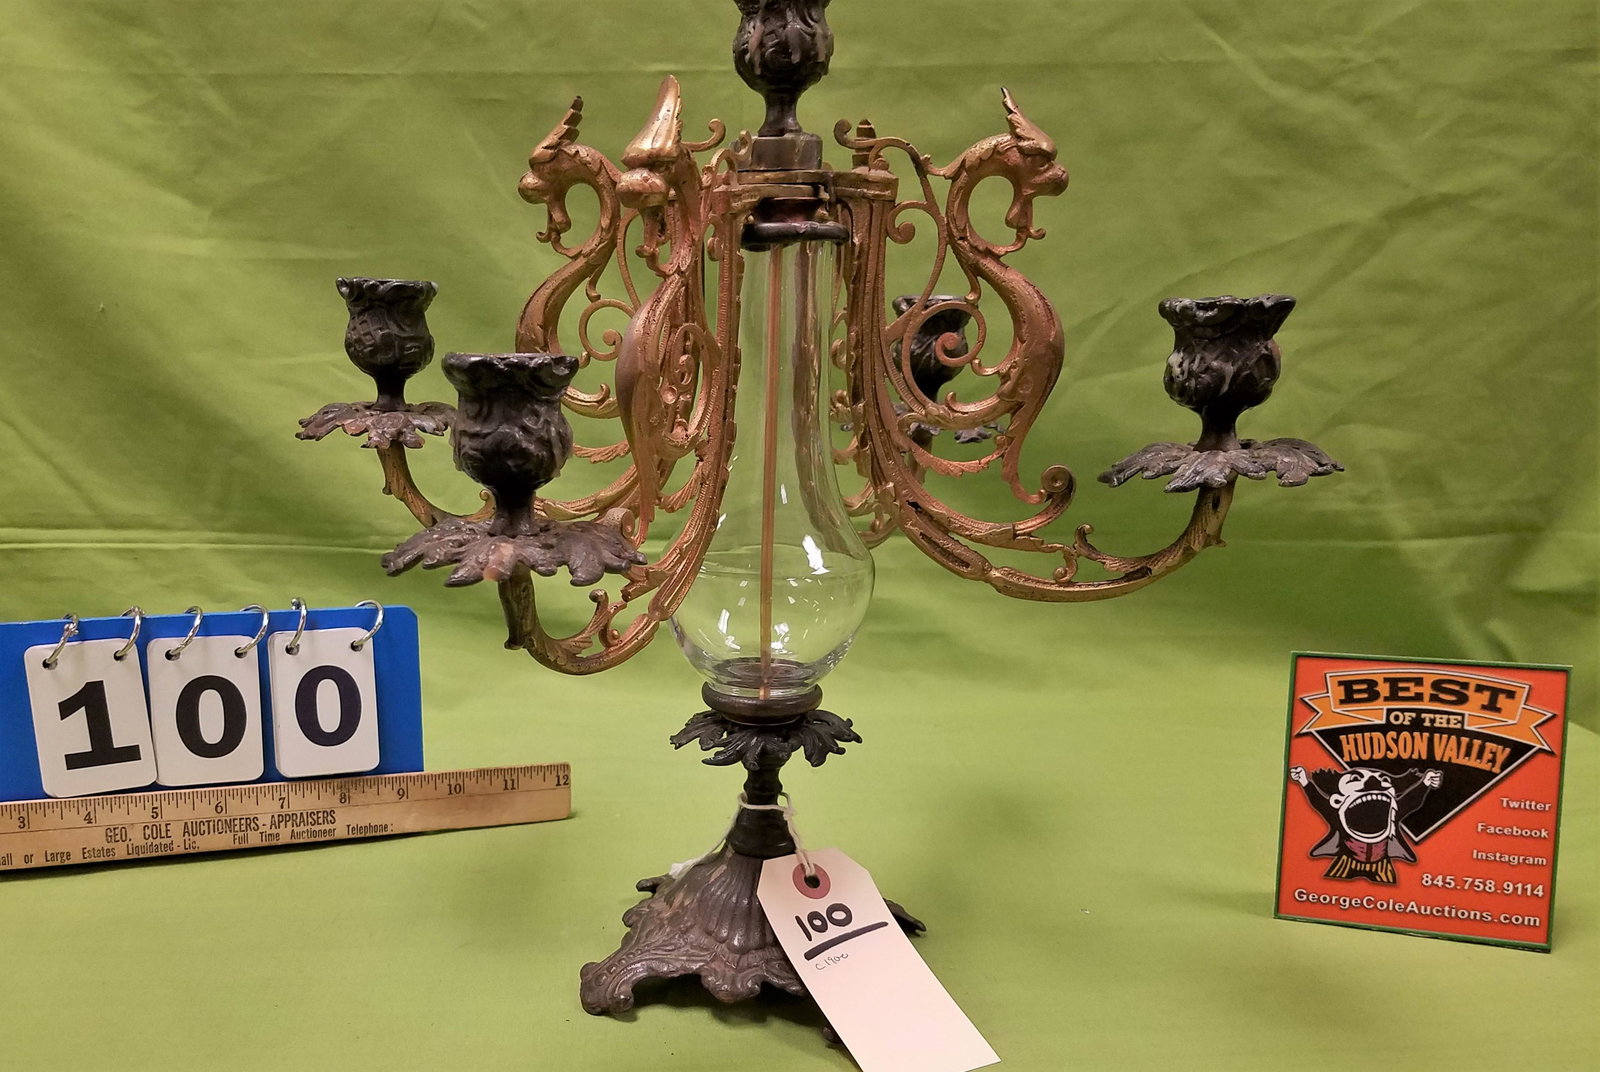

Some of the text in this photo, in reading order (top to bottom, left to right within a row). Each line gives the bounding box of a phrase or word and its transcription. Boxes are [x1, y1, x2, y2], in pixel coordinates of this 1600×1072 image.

[1337, 676, 1516, 713] BEST
[1389, 710, 1463, 729] OF THE
[1339, 731, 1512, 775] HUDSON VALLEY
[18, 774, 569, 829] 3 4 5 6 7 8 9 10 11 12
[1501, 797, 1551, 812] Twitter
[0, 856, 13, 867] all
[23, 853, 35, 864] or
[44, 851, 72, 864] Large
[81, 846, 116, 860] Estates
[126, 840, 174, 856] Liquidated
[183, 838, 200, 851] Lic.
[232, 833, 249, 845] Full
[259, 830, 281, 843] Time
[290, 828, 337, 841] Auctioneer
[346, 822, 394, 837] Telephone:
[105, 826, 132, 844] GEO.
[143, 822, 172, 841] COLE
[182, 816, 260, 838] AUCTIONEERS
[269, 809, 336, 830] APPRAISERS
[1476, 822, 1550, 840] Facebook
[1471, 849, 1547, 866] Instagram
[1421, 873, 1545, 898] 845.758.9114
[794, 902, 853, 942] 100
[1293, 888, 1541, 928] GeorgeColeAuctions.com
